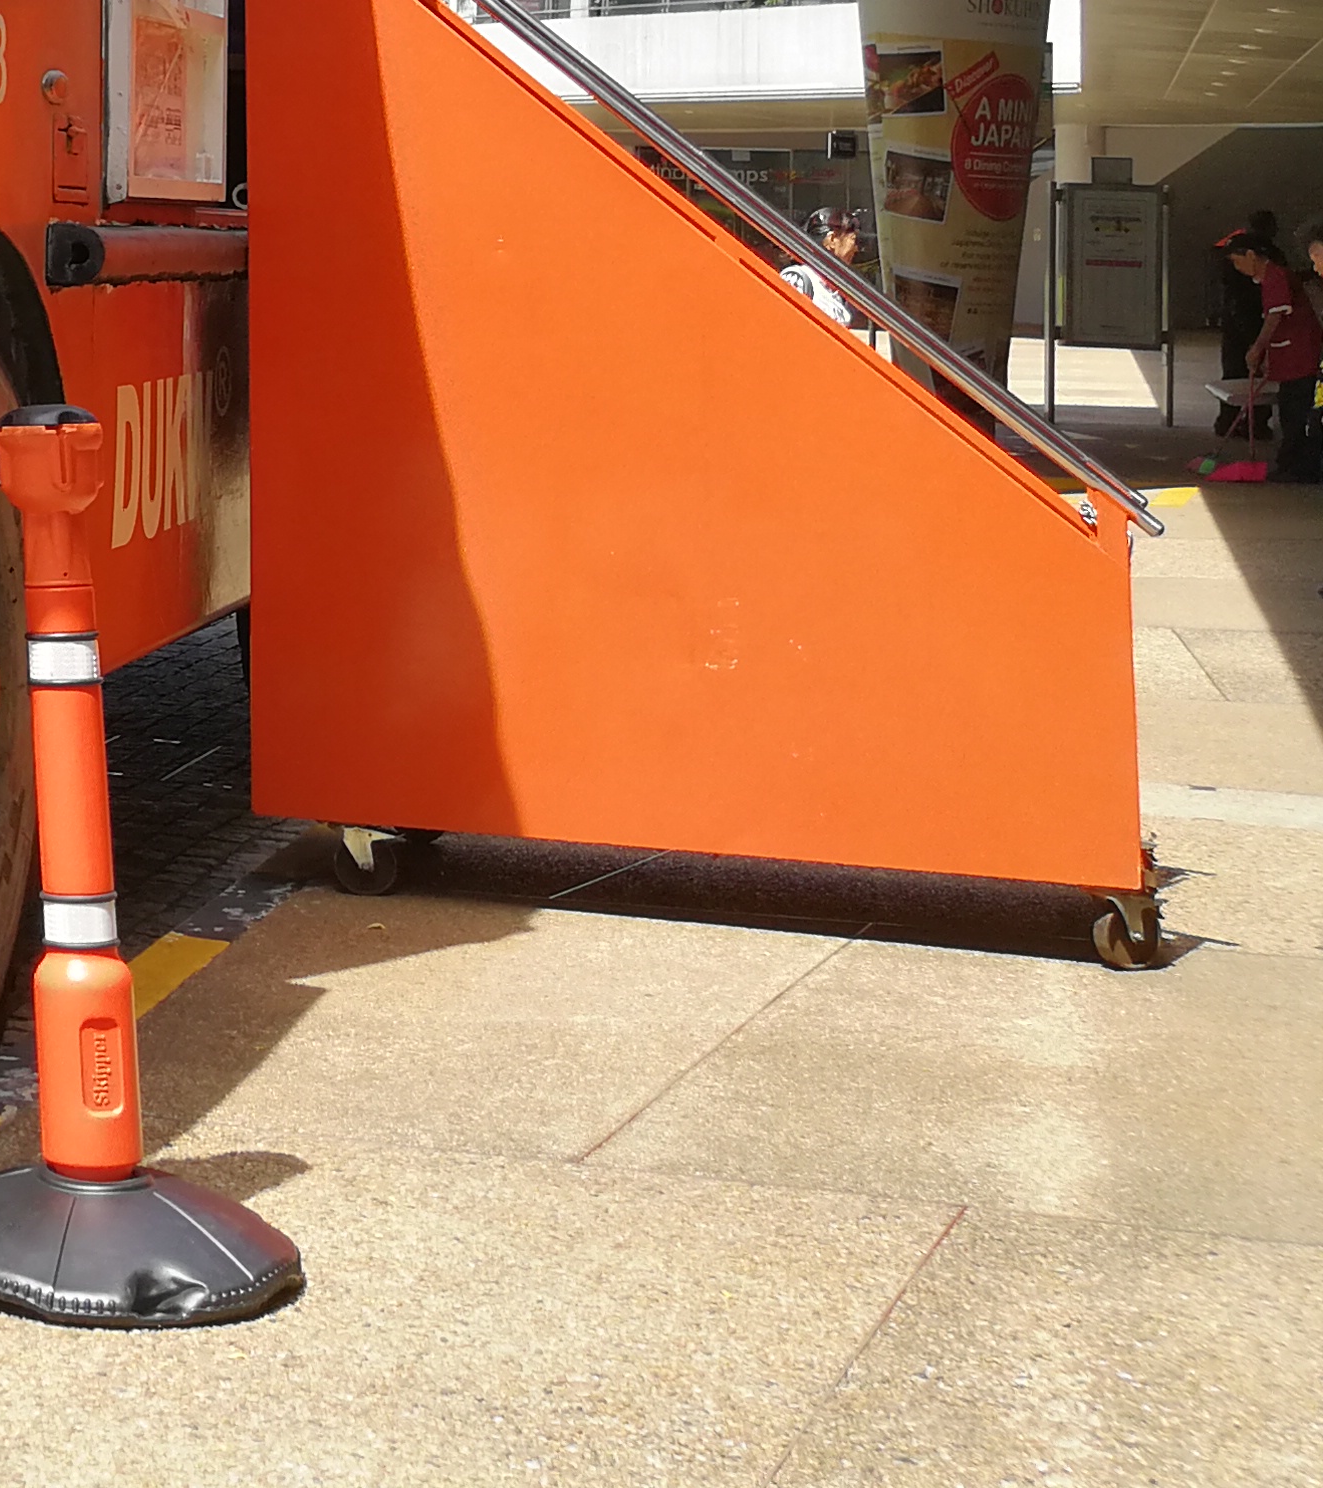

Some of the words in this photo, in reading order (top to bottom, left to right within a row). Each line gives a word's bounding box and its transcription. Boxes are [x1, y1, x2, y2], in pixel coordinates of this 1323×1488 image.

[974, 96, 991, 121] A
[971, 122, 1031, 149] JAPAN
[92, 1032, 113, 1107] Skipper
